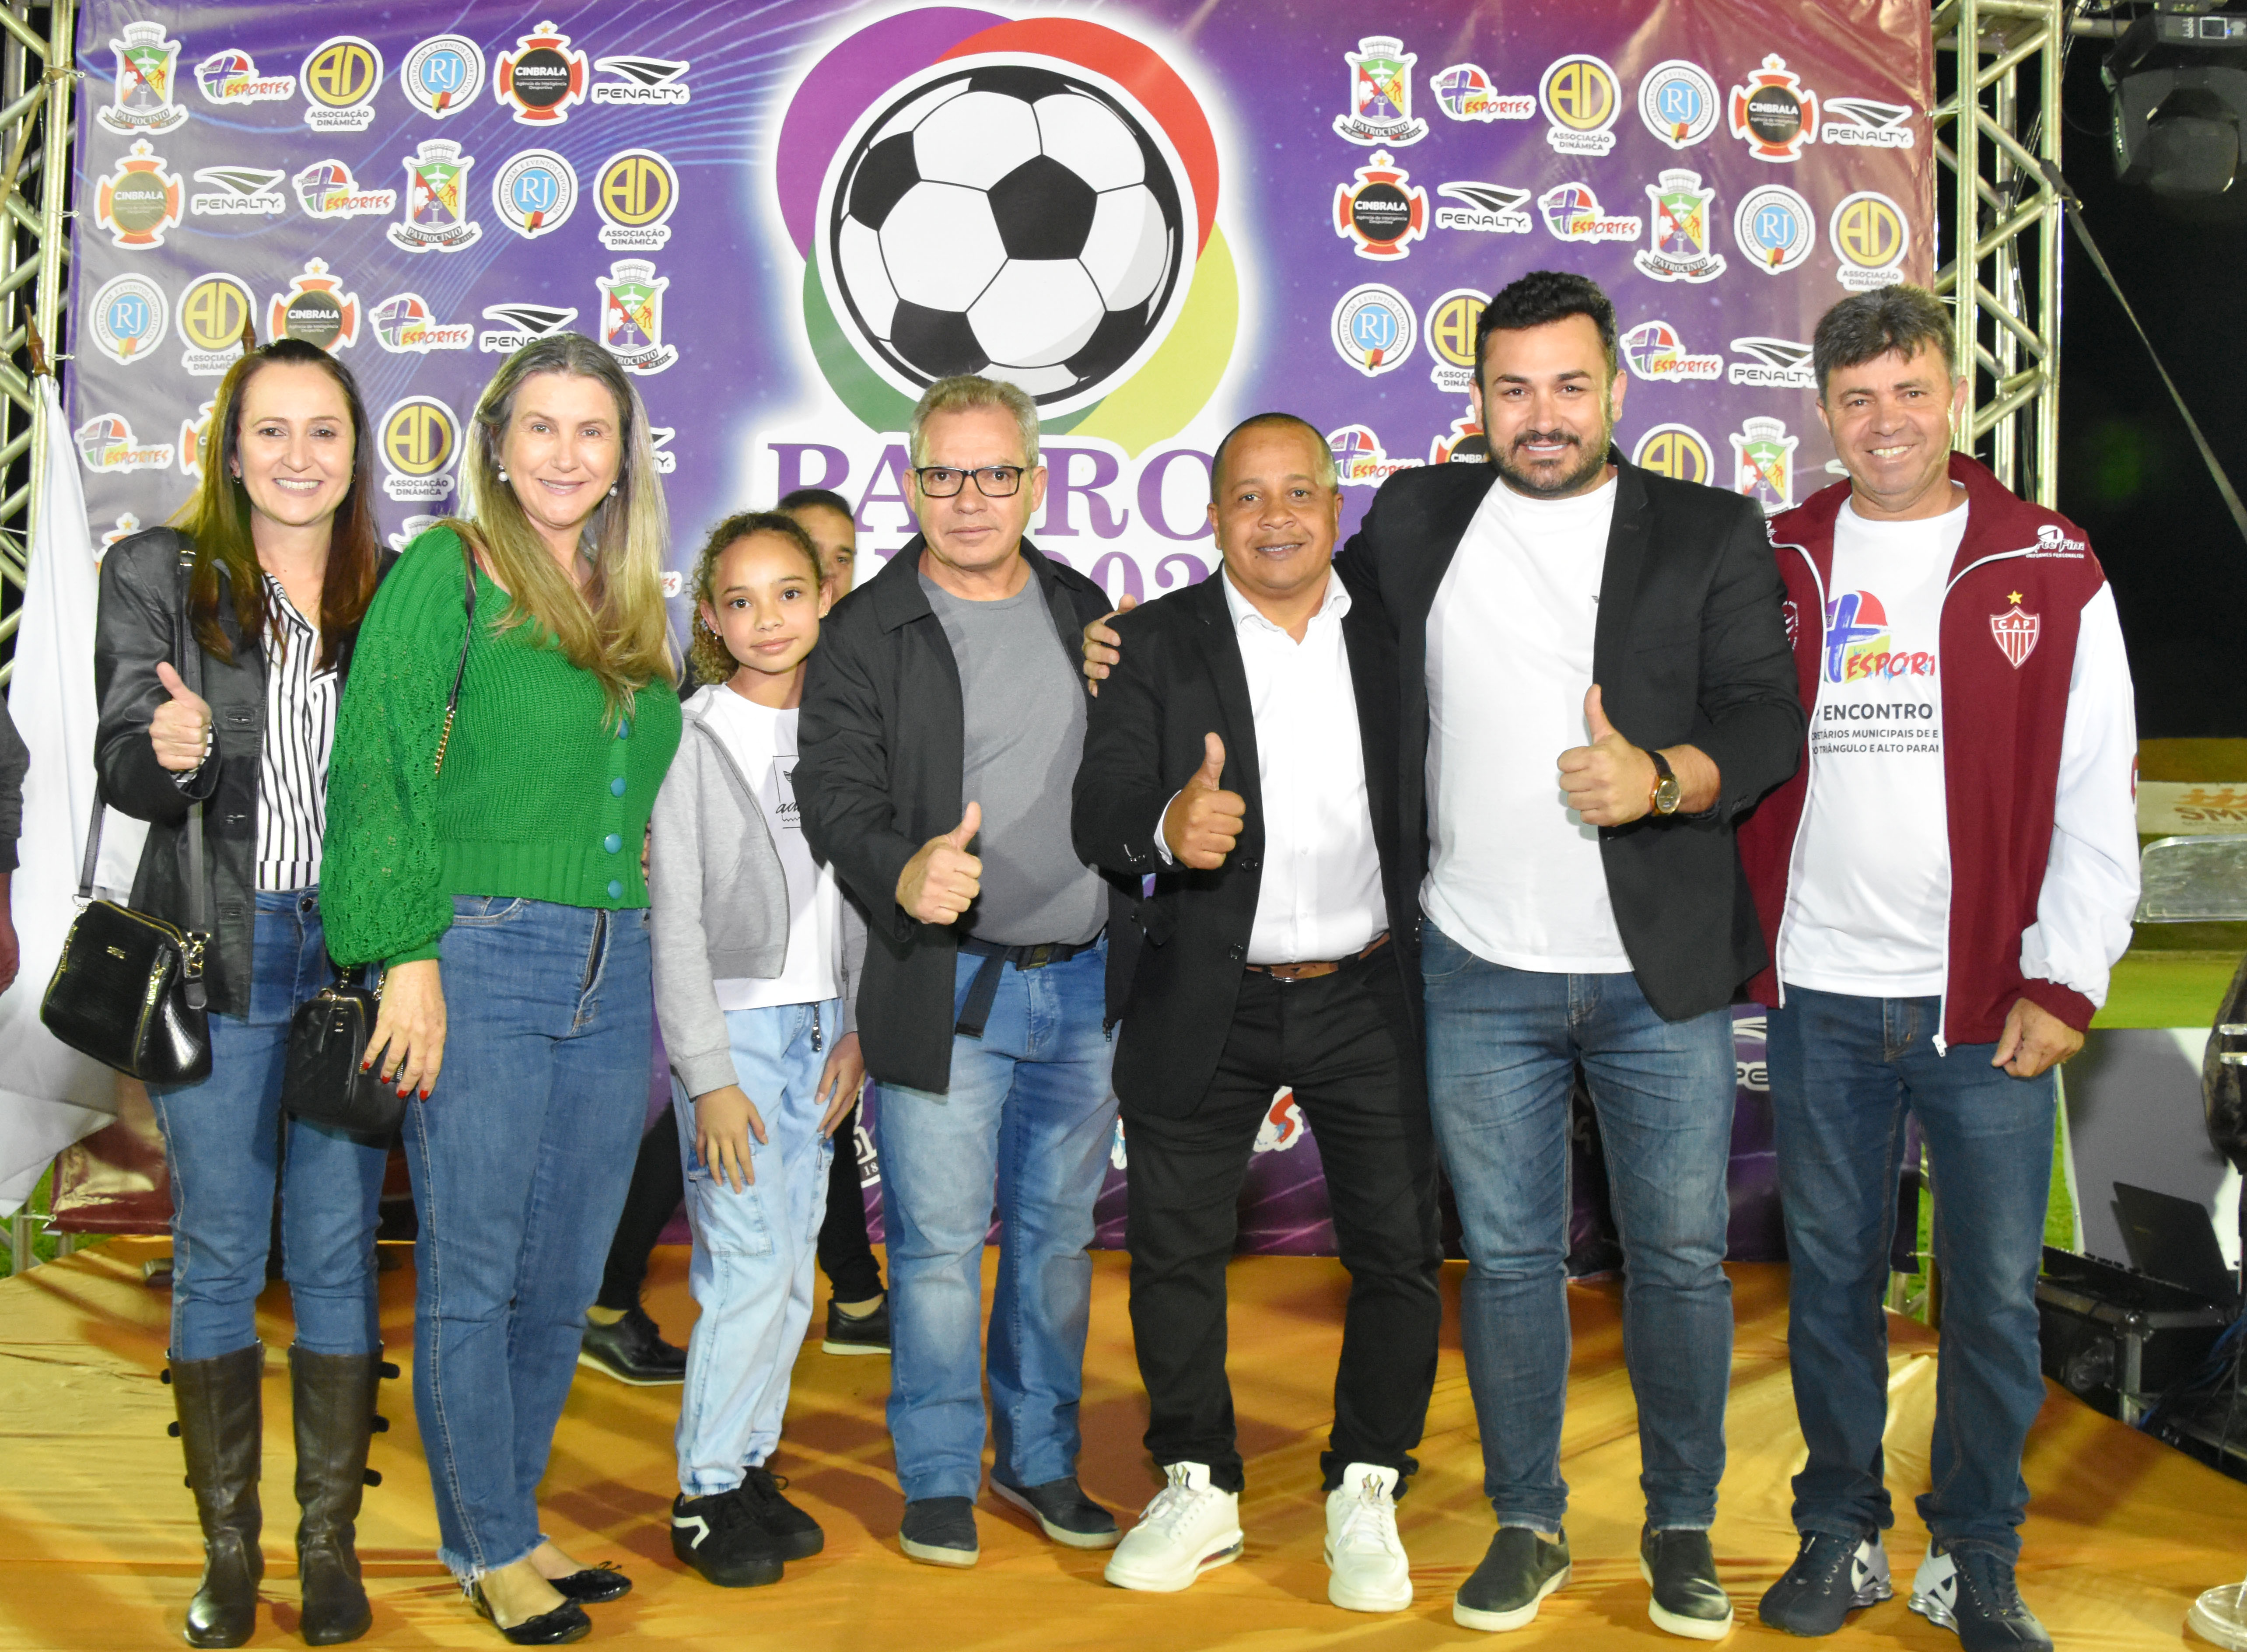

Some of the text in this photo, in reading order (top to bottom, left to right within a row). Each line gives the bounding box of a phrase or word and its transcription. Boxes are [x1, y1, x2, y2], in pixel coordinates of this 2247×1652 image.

[413, 51, 428, 93] ARBITRAGEM
[435, 43, 465, 53] EVENTOS
[461, 52, 474, 94] ESPORTIVOS
[428, 59, 458, 89] RJ
[515, 66, 567, 76] CINBRALA
[226, 81, 290, 97] ESPORTES
[1465, 101, 1530, 113] ESPORTES
[1665, 88, 1694, 120] RJ
[1749, 102, 1799, 115] CINBRALA
[311, 109, 369, 120] ASSOCIAÇÃO
[1553, 132, 1610, 144] ASSOCIAÇÃO
[1559, 141, 1603, 150] DINÂMICA
[503, 168, 519, 213] ARBITRAGEM
[526, 160, 557, 172] EVENTOS
[553, 171, 566, 214] ESPORTIVOS
[520, 177, 551, 208] RJ
[115, 191, 164, 200] CINBRALA
[326, 195, 390, 210] ESPORTES
[1354, 201, 1407, 211] CINBRALA
[605, 229, 665, 238] ASSOCIAÇÃO
[1573, 221, 1636, 234] ESPORTES
[1761, 213, 1790, 245] RJ
[611, 237, 658, 245] DINÂMICA
[115, 302, 144, 334] RJ
[288, 310, 339, 319] CINBRALA
[1341, 304, 1356, 348] ARBITRAGEM
[1364, 295, 1396, 308] EVENTOS
[1393, 308, 1406, 353] ESPORTIVOS
[1360, 313, 1390, 346] RJ
[402, 330, 467, 345] ESPORTES
[193, 361, 231, 370] DINÂMIC
[1654, 360, 1717, 373] ESPORTES
[106, 450, 168, 463] ESPORTES
[389, 479, 448, 488] ASSOCIAÇÃO
[768, 443, 1217, 541] PARO
[1847, 651, 1935, 679] ESPORT
[1824, 704, 1933, 721] ENCONTRO
[1852, 729, 1914, 738] MUNICIPAIS
[1819, 743, 1867, 753] TRIÂNGULO
[1877, 744, 1904, 752] ALTO
